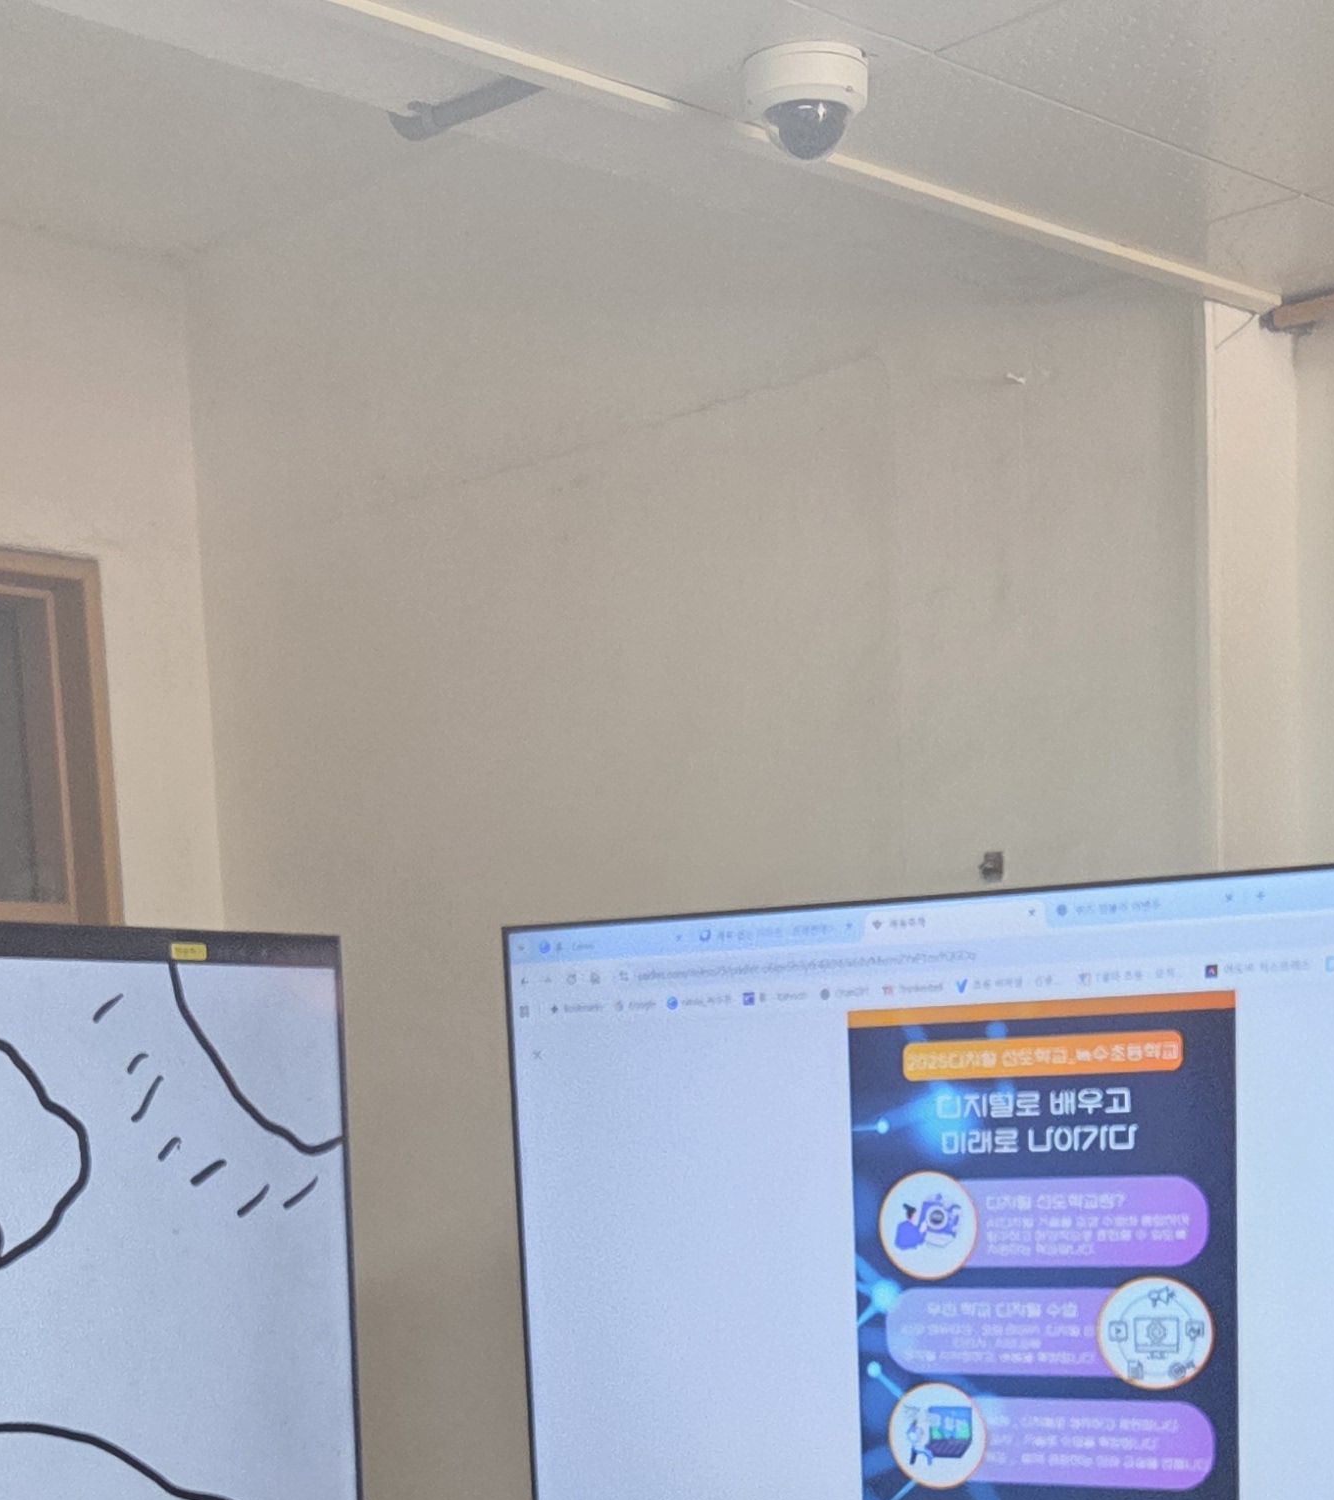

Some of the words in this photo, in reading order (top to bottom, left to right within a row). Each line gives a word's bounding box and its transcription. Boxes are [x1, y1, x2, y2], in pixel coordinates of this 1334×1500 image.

[935, 1090, 1041, 1119] 디지털로
[1049, 1086, 1132, 1116] 배우고
[941, 1126, 1019, 1155] 미래로
[1027, 1123, 1140, 1153] 나아가다
